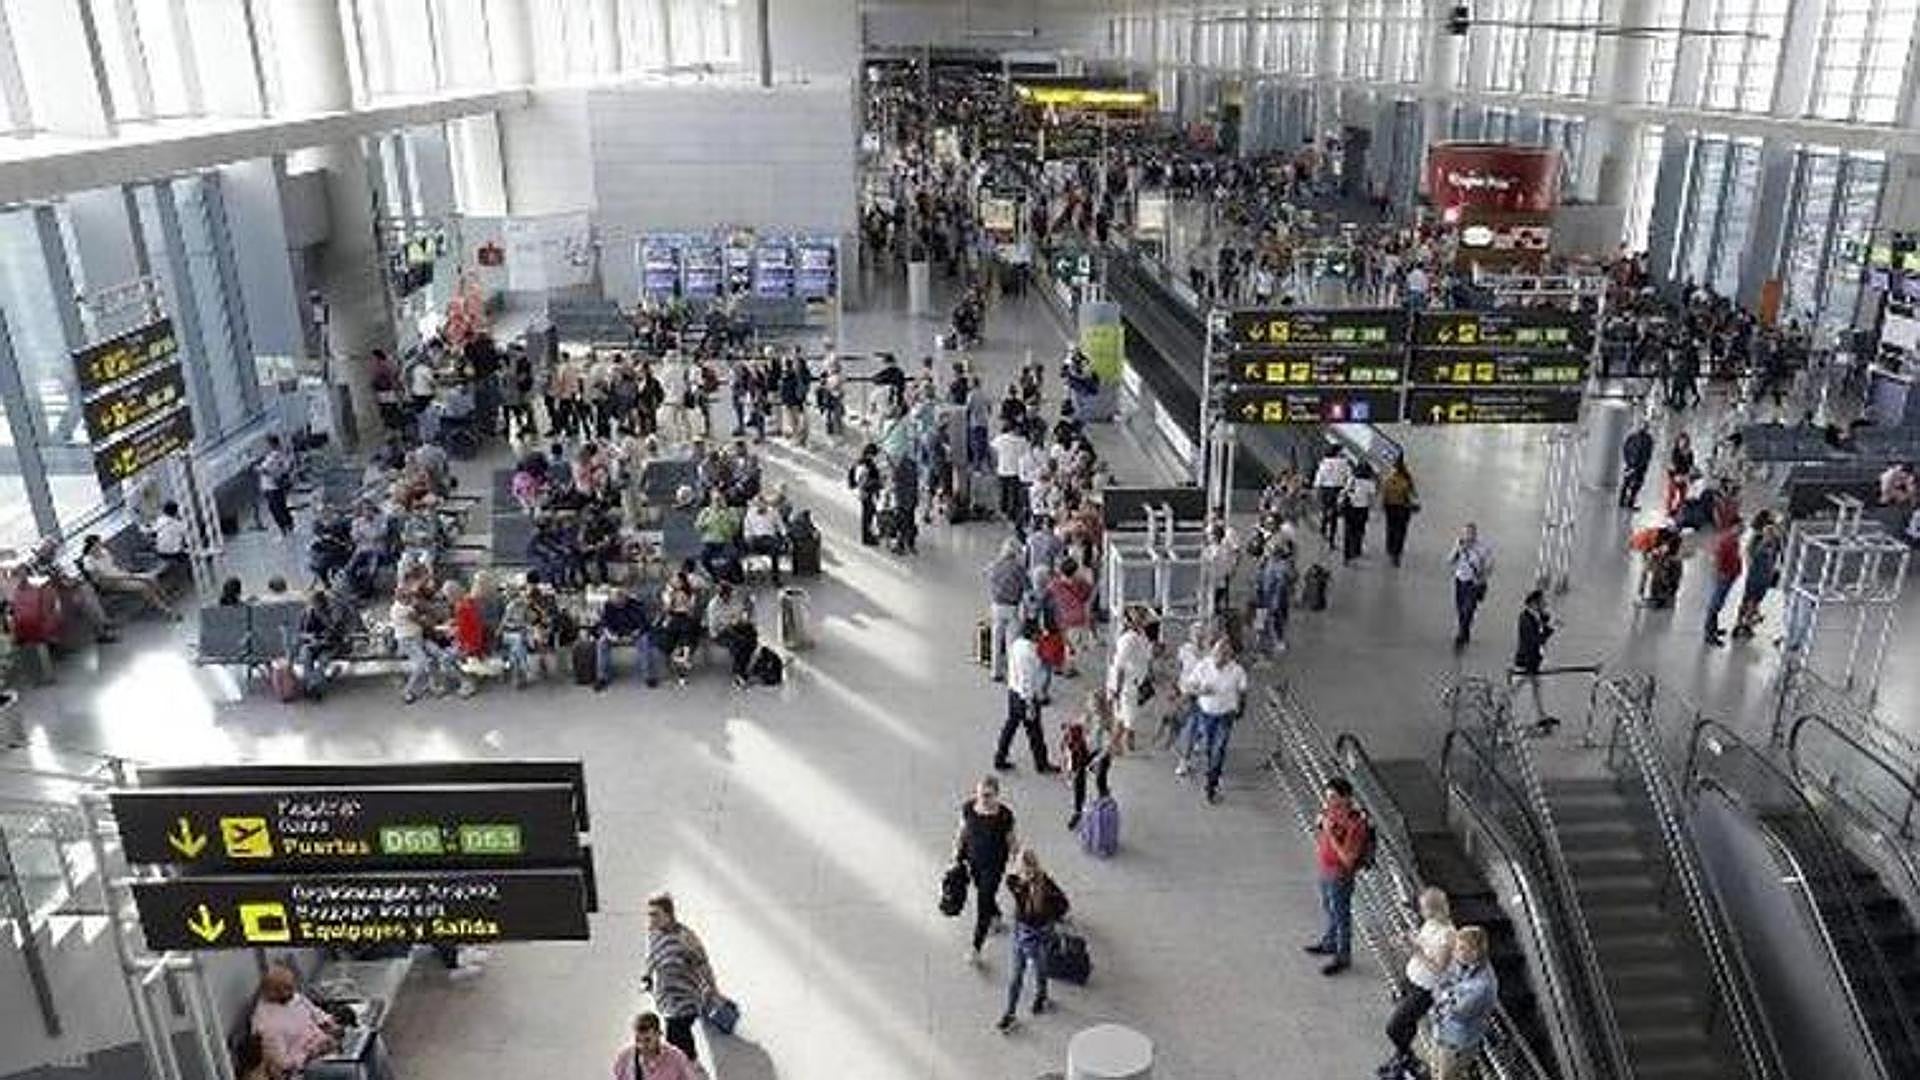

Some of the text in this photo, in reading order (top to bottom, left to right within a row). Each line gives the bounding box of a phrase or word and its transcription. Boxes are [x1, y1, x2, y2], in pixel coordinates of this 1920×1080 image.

[282, 837, 371, 856] Puertas
[300, 921, 406, 942] Equipajes
[432, 918, 499, 935] Salida
